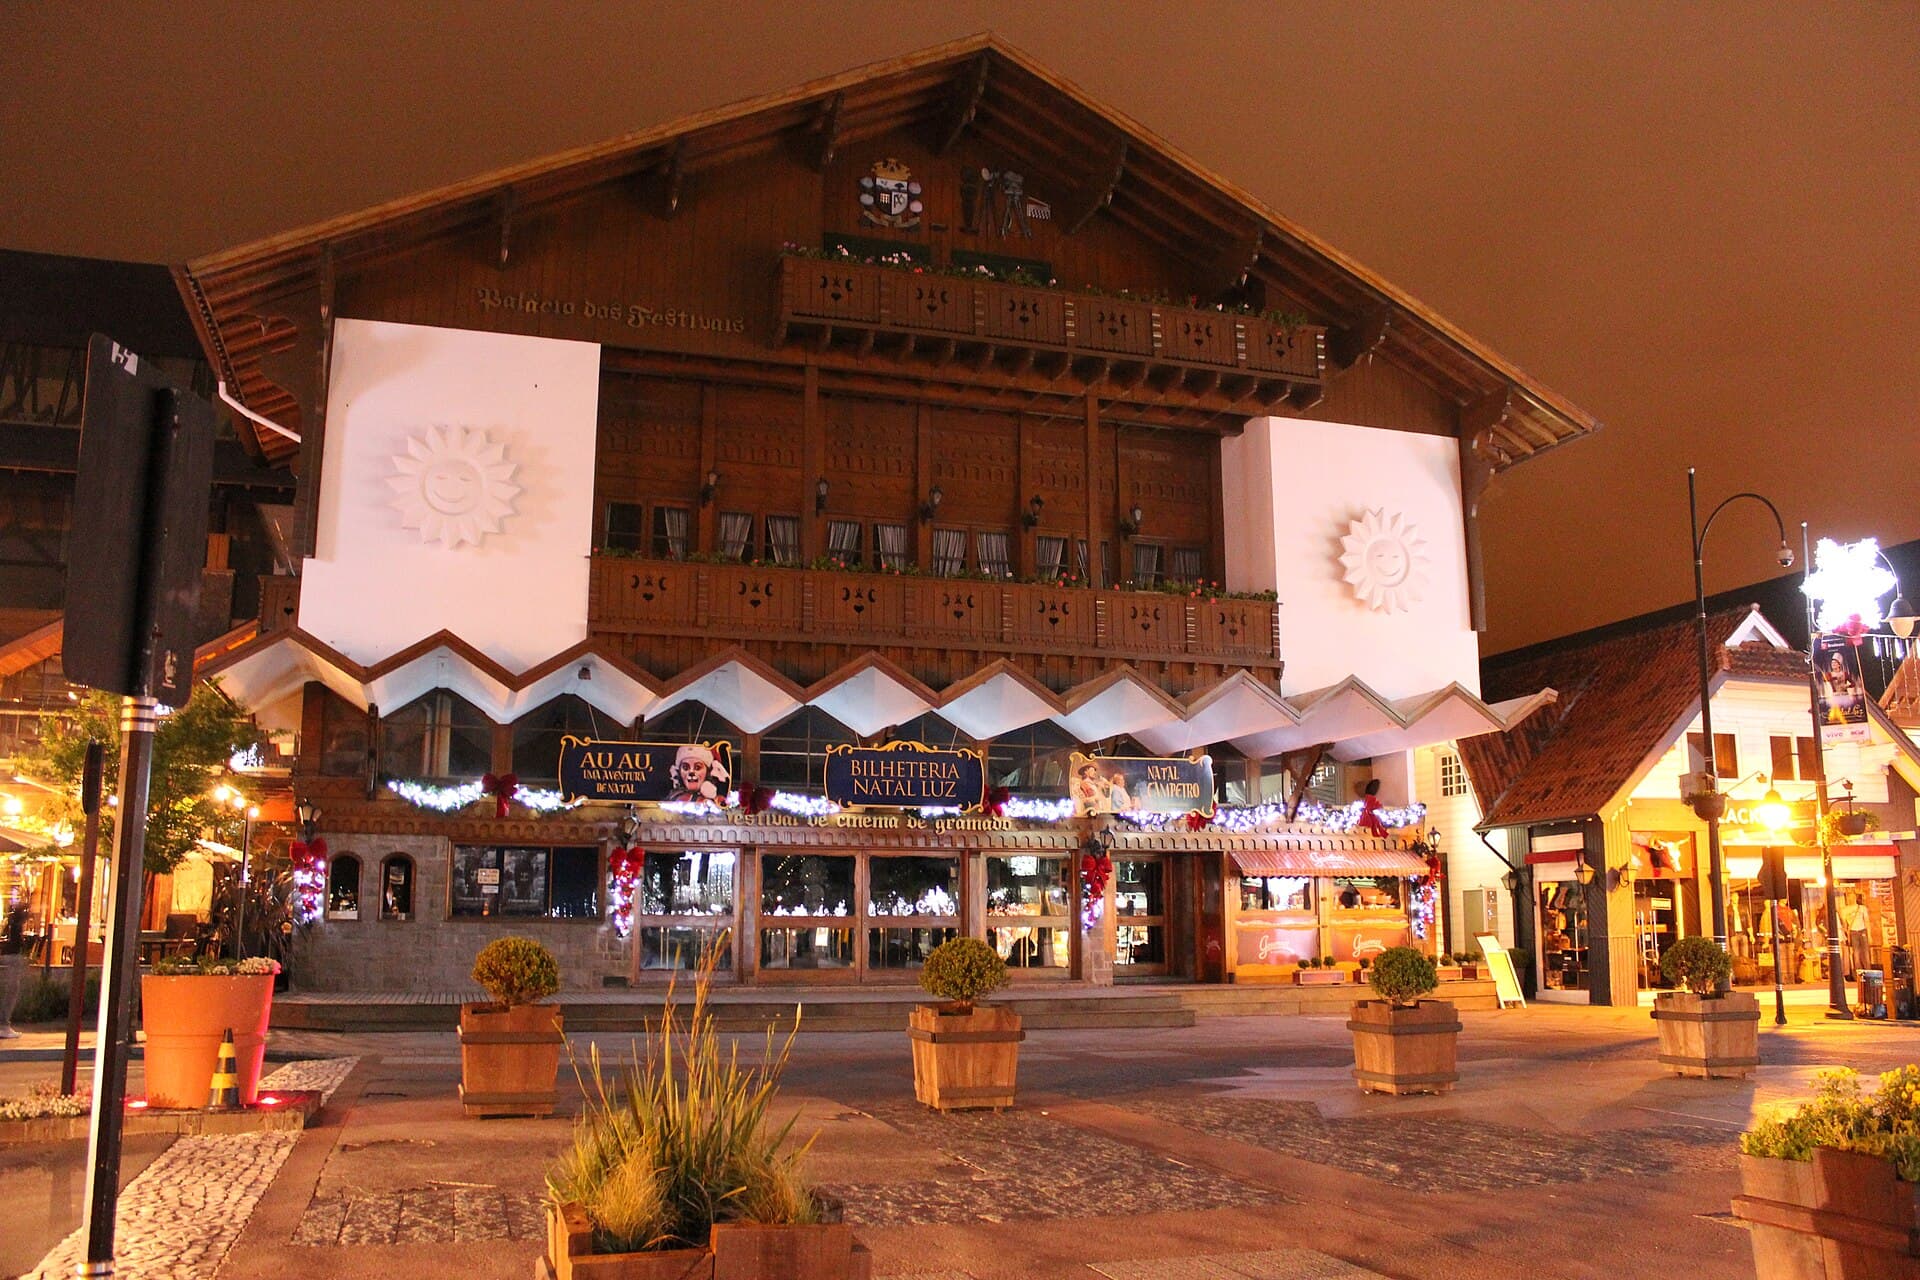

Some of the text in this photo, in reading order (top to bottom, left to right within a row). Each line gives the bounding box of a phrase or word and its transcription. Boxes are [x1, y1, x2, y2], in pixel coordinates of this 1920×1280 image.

[583, 299, 623, 320] dos
[626, 303, 746, 334] Festivais
[579, 752, 655, 773] AU AU,
[850, 759, 961, 779] BILHETERIA
[583, 769, 646, 783] UMA AVENTURA
[1147, 765, 1180, 780] NATAL
[596, 783, 636, 795] DE NATAL
[853, 779, 958, 798] NATAL LUZ
[836, 814, 899, 829] cinema
[906, 813, 928, 829] de
[935, 814, 1012, 834] gramado
